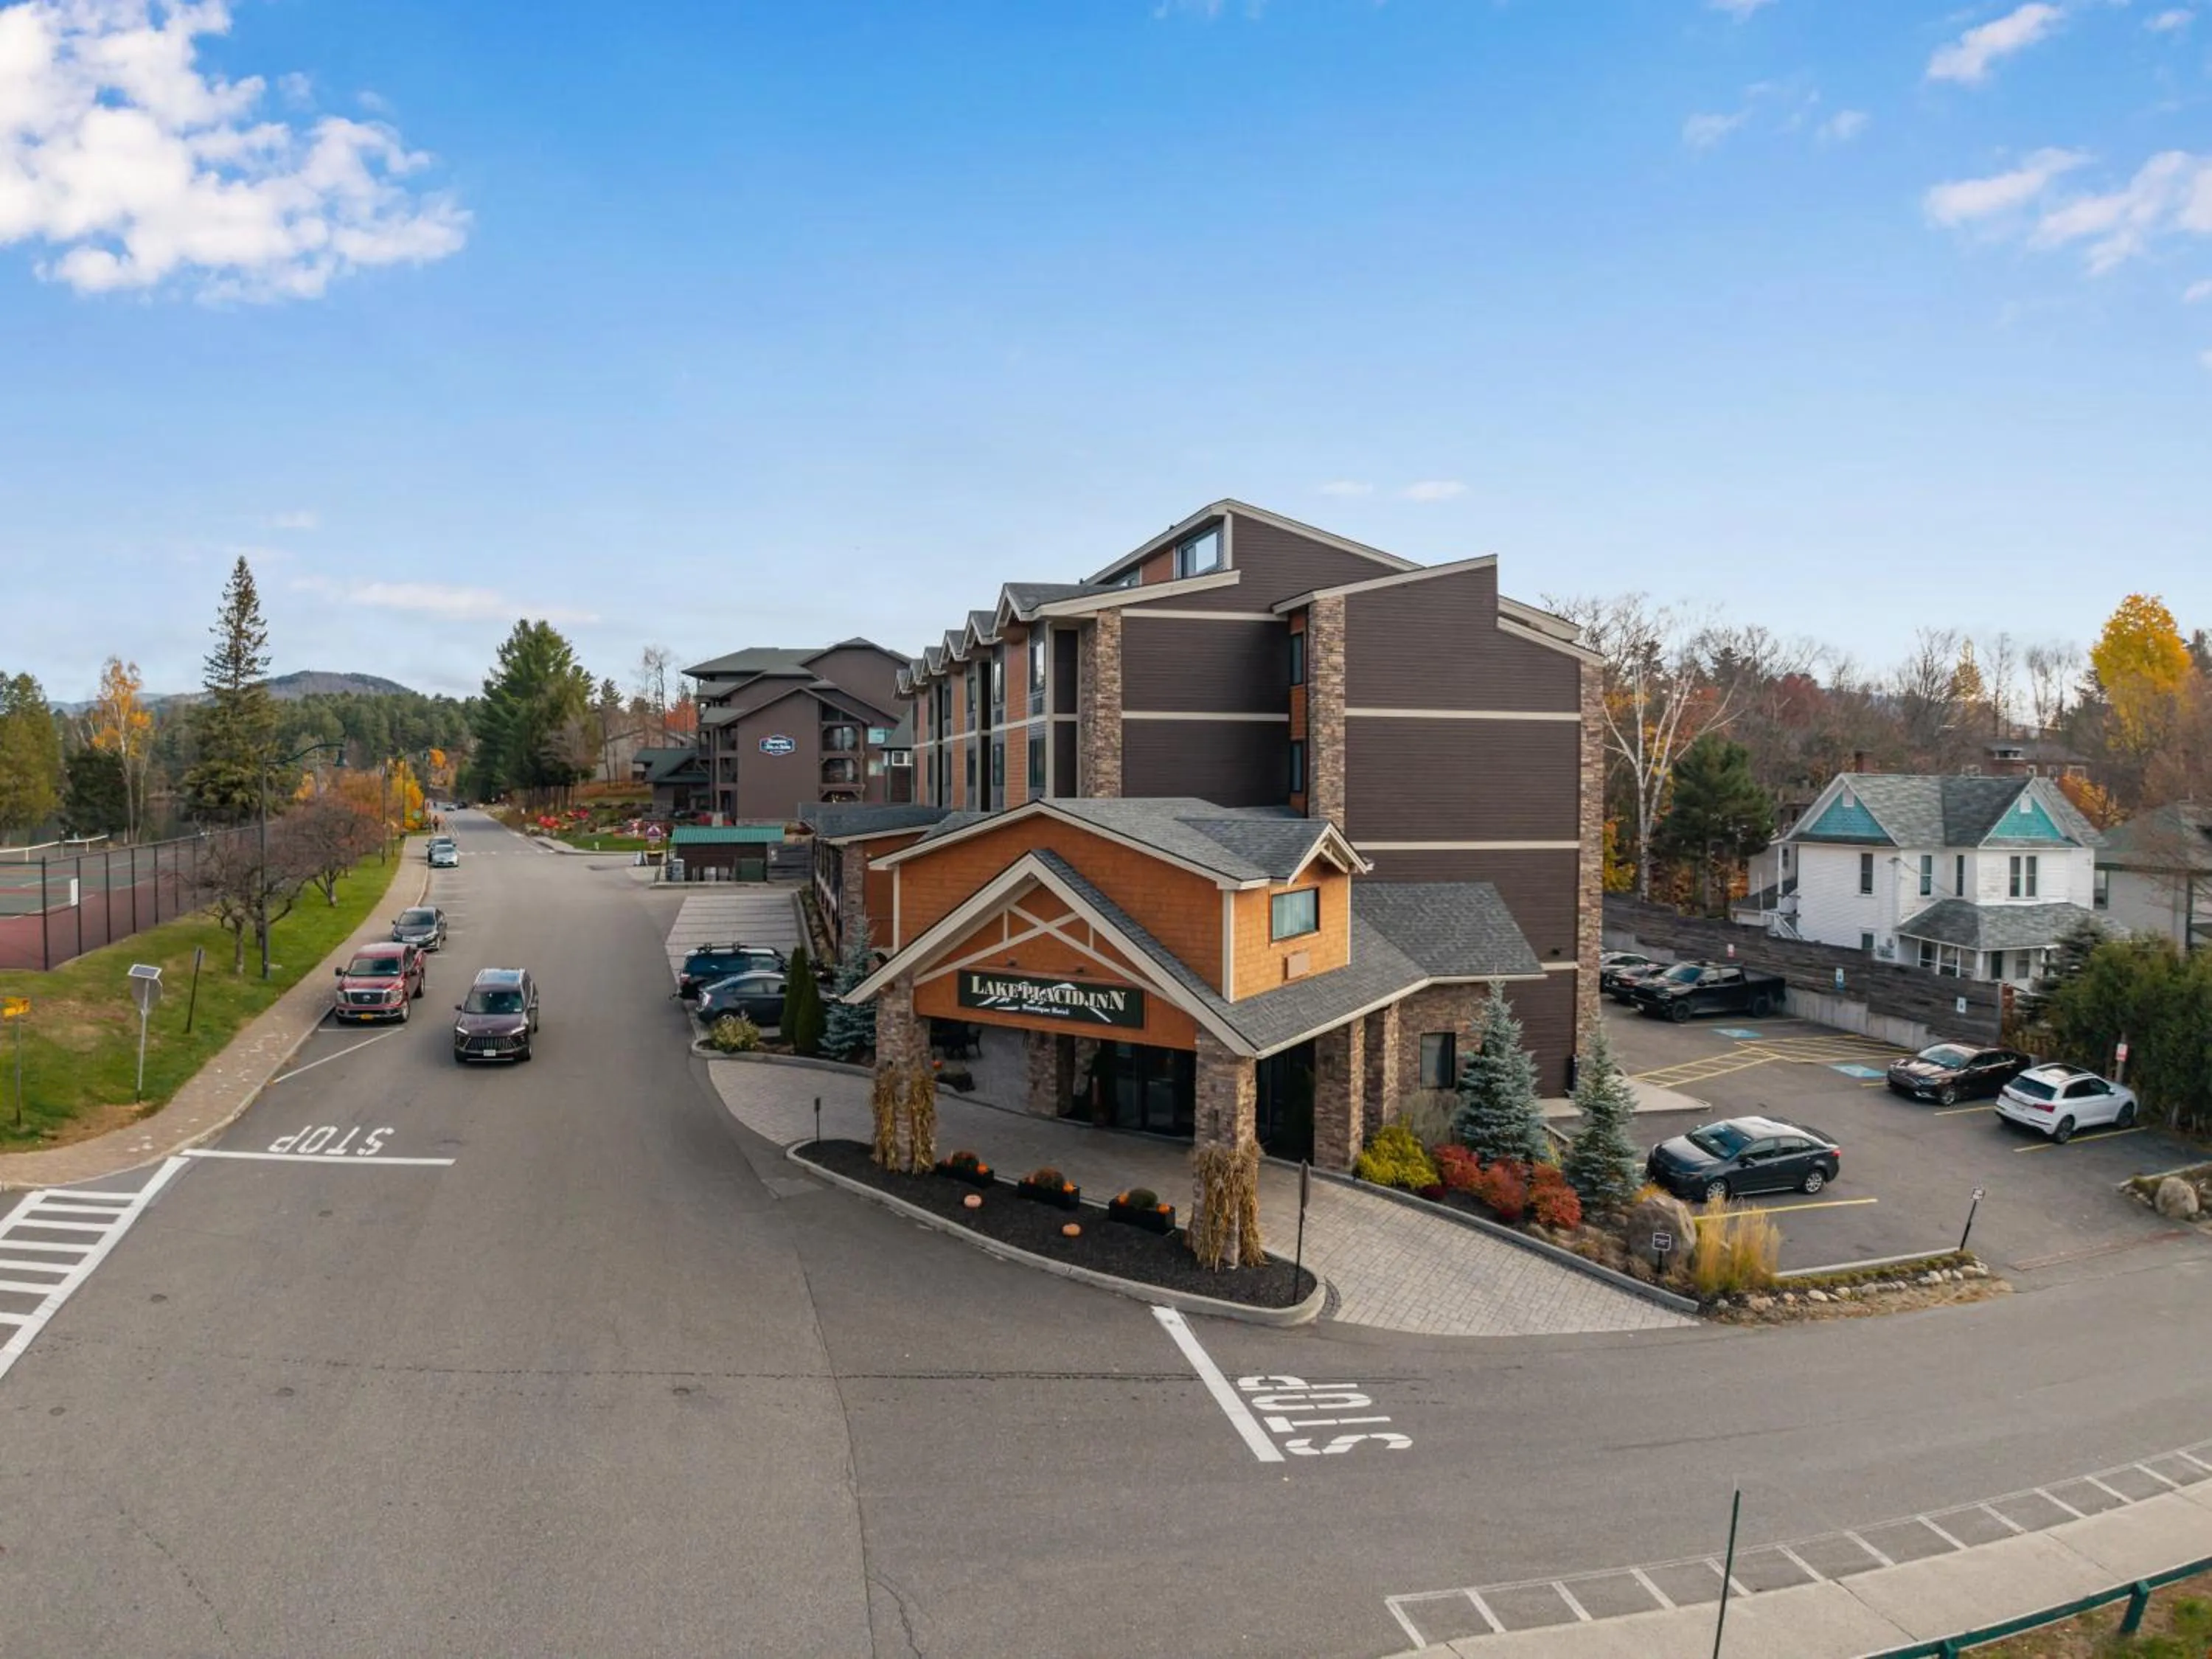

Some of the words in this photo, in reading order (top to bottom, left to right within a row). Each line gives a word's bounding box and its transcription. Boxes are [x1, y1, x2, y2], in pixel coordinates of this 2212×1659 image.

[971, 975, 1018, 998] LAKE
[1020, 984, 1085, 1006] PLACID
[1089, 990, 1127, 1012] INN
[268, 1125, 395, 1155] STOP
[1237, 1375, 1413, 1455] STOP
